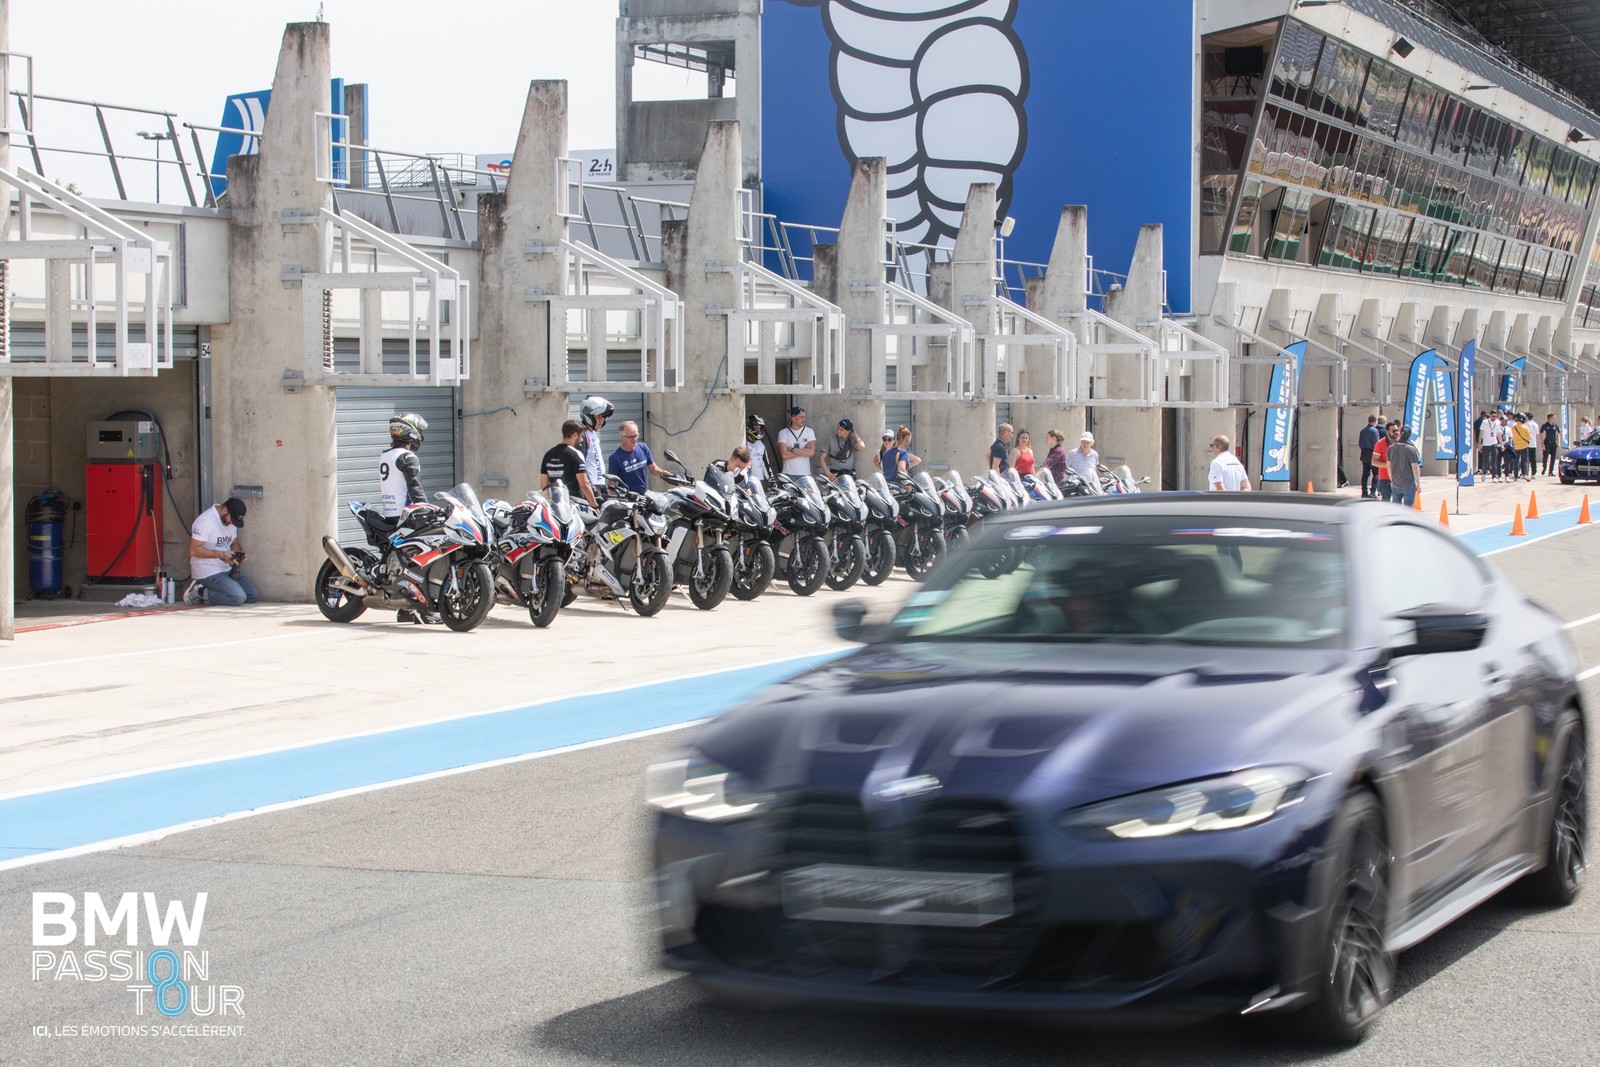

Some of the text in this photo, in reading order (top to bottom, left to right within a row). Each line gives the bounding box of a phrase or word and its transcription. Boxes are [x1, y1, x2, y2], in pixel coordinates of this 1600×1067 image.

[1274, 361, 1291, 444] MICHELI
[1411, 362, 1427, 436] MICHELIN
[1463, 357, 1471, 447] MICHELIN
[380, 462, 389, 481] 9
